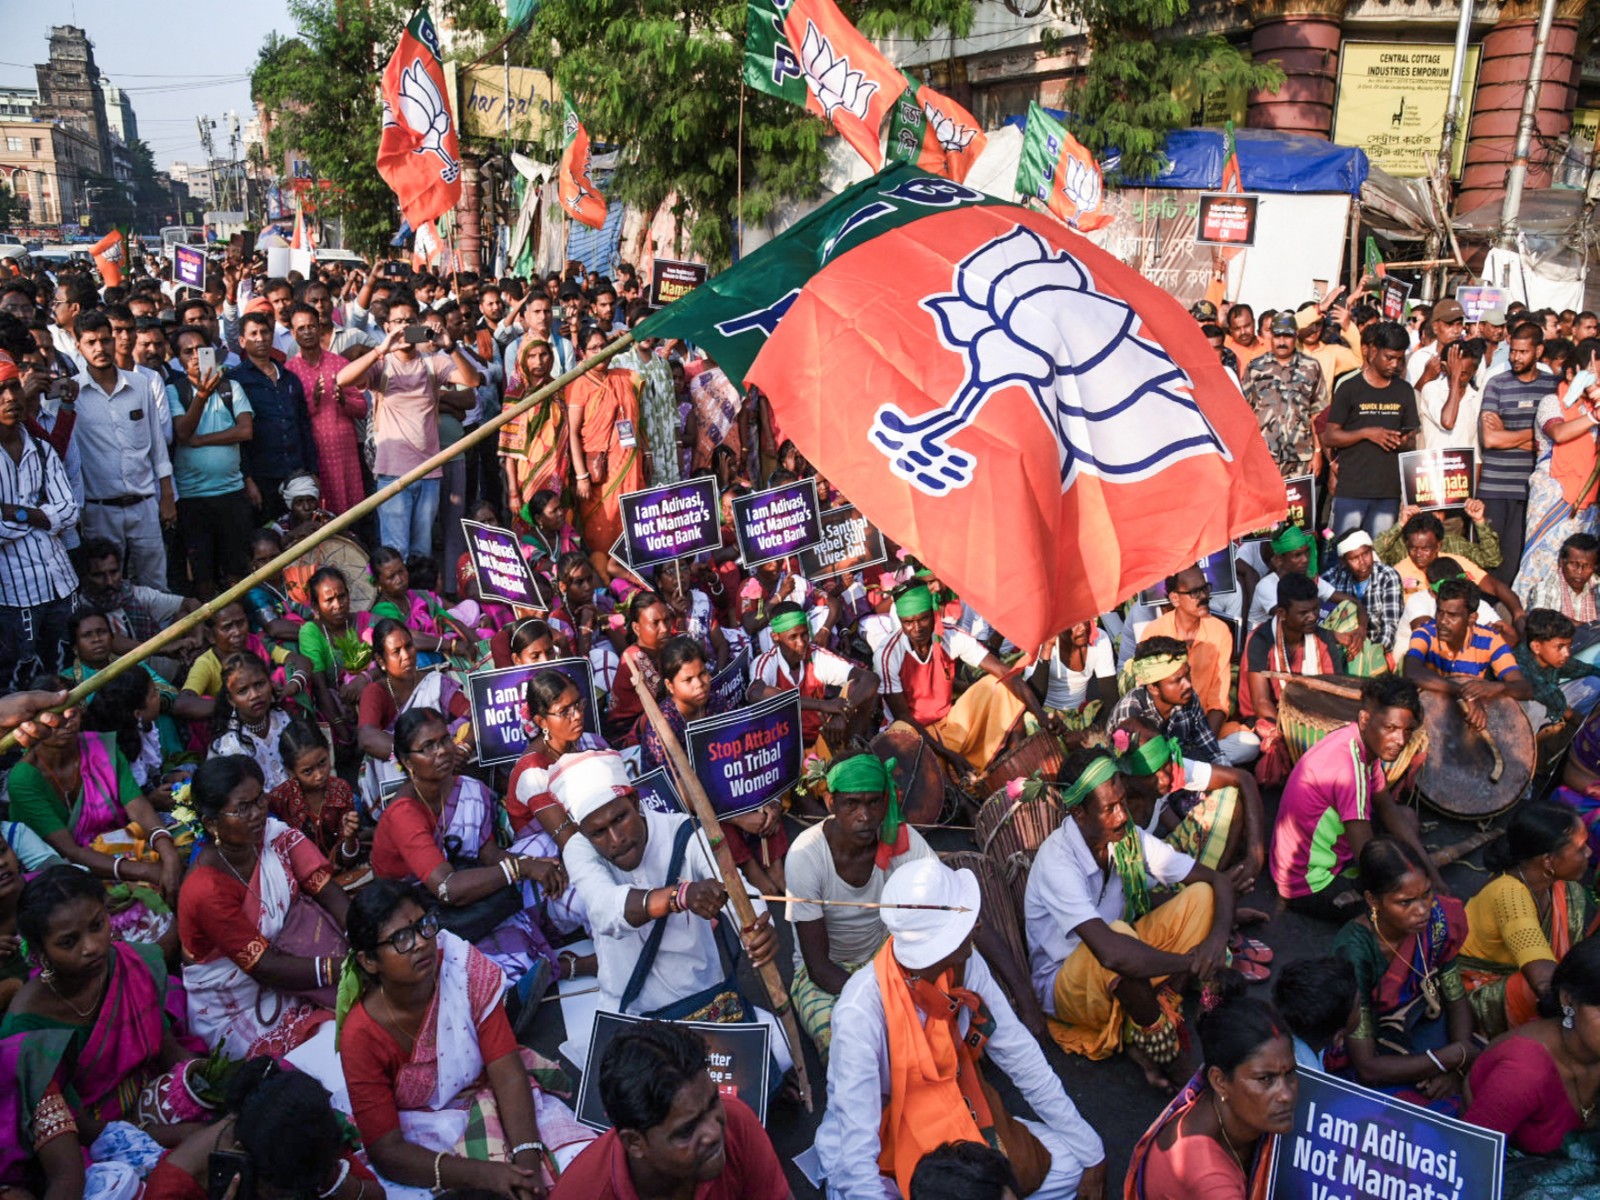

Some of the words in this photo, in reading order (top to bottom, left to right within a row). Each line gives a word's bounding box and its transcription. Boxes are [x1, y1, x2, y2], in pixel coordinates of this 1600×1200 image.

[1367, 66, 1410, 77] INDUSTRIES
[1412, 67, 1449, 77] EMPORIUM
[1380, 53, 1409, 64] CENTRAL
[1411, 54, 1441, 64] COTTAGE
[467, 80, 498, 112] har
[635, 505, 640, 521] I
[641, 503, 660, 520] am
[662, 491, 704, 515] Adivasi,
[746, 508, 750, 522] I
[752, 505, 769, 519] am
[770, 493, 806, 515] Adivasi,
[633, 520, 656, 538] Not
[656, 507, 710, 533] Mamata's
[746, 521, 766, 538] Not
[766, 508, 812, 532] Mamata's
[757, 534, 783, 550] Vote
[783, 523, 806, 544] Bank
[826, 516, 868, 538] Santhal
[646, 534, 673, 551] Vote
[675, 525, 702, 545] Bank
[477, 551, 493, 569] Not
[818, 554, 847, 567] Lives
[486, 688, 493, 705] I
[495, 686, 519, 704] am
[484, 705, 513, 727] Not
[708, 740, 741, 761] Stop
[745, 720, 790, 751] Attacks
[724, 760, 743, 778] on
[744, 742, 782, 769] Tribal
[729, 767, 780, 798] Women
[1293, 1136, 1338, 1181] Not
[1306, 1102, 1316, 1132] I
[1319, 1112, 1358, 1148] am
[1361, 1122, 1464, 1188] Adivasi,
